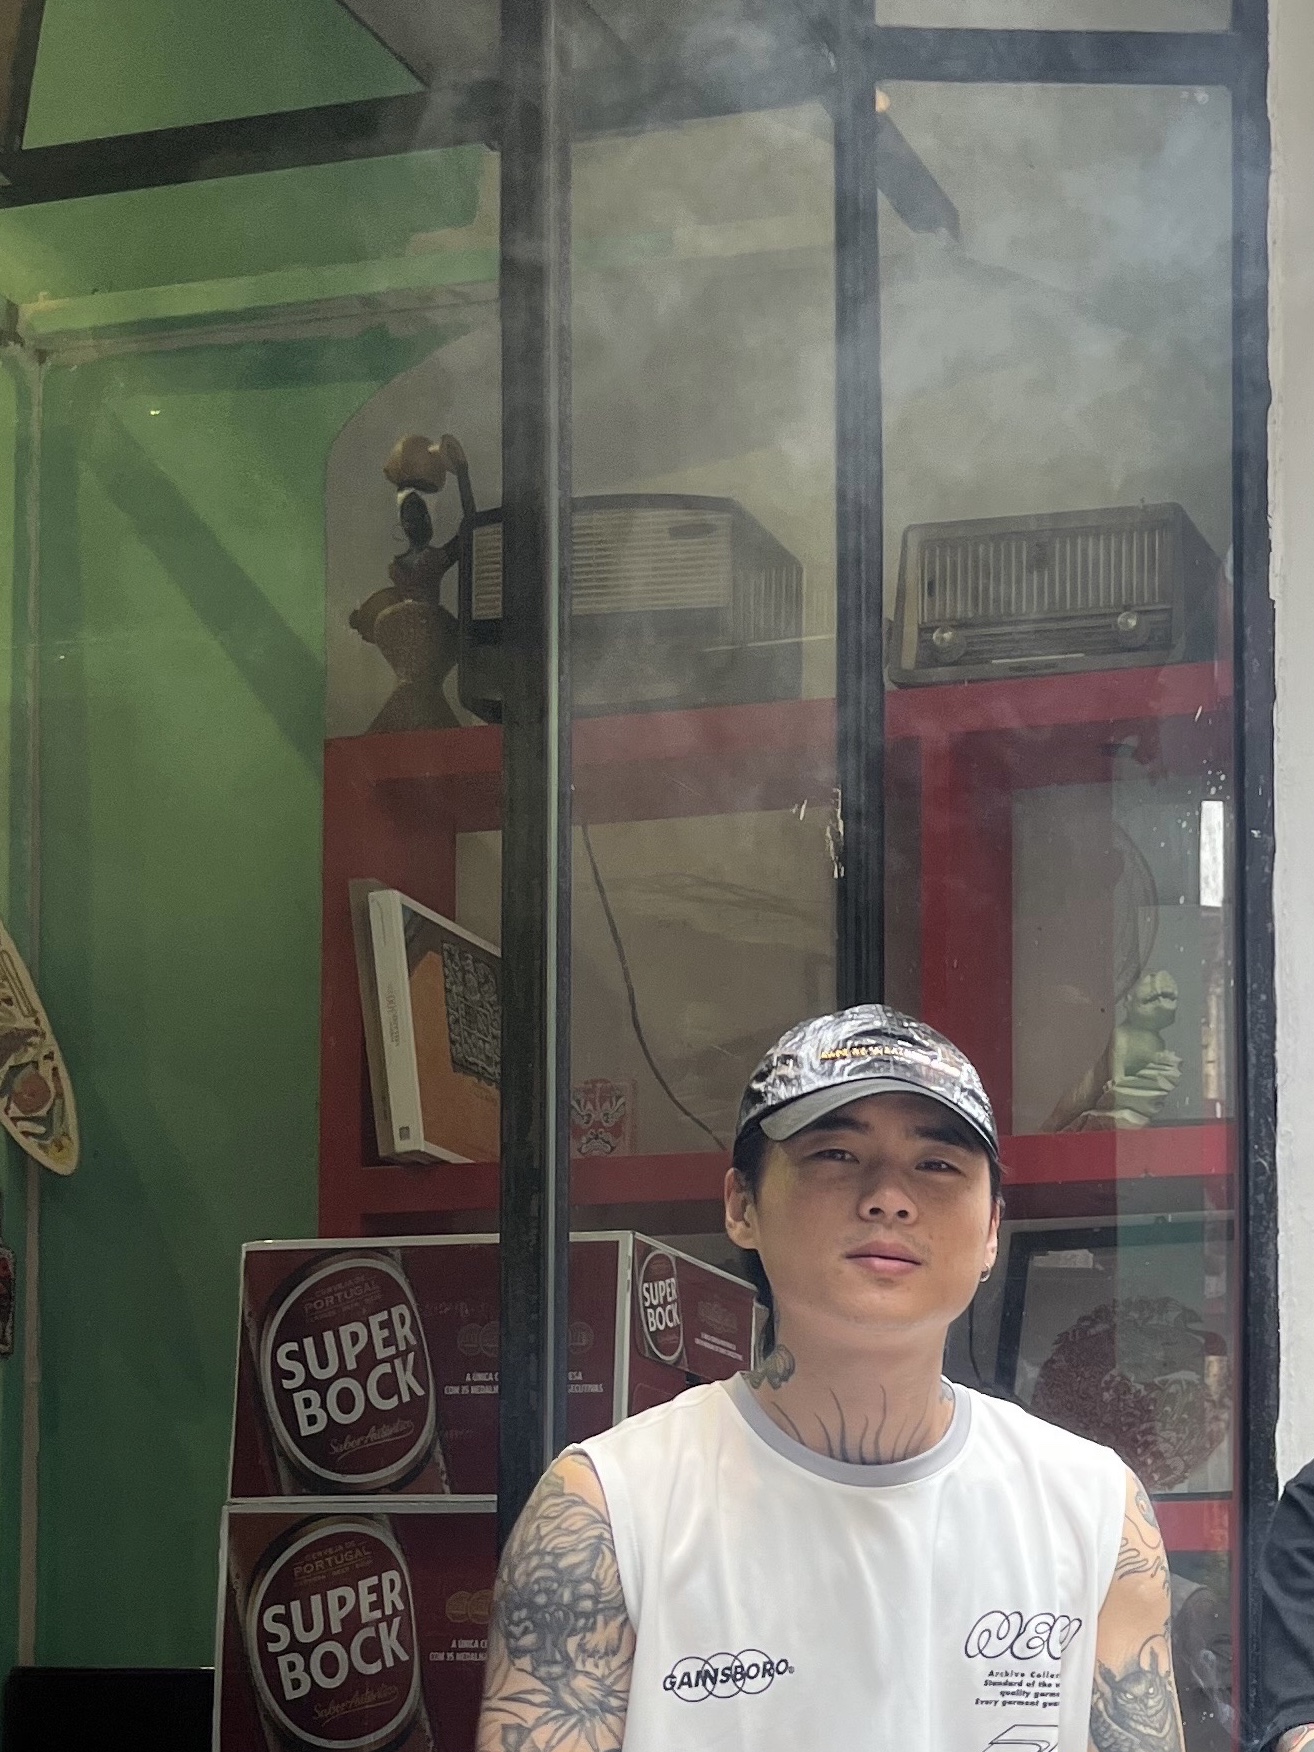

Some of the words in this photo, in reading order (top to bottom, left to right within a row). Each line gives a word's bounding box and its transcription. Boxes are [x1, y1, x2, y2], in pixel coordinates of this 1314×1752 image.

[642, 1277, 678, 1307] SUPER
[646, 1302, 681, 1332] BOCK
[276, 1303, 418, 1390] SUPER
[292, 1352, 426, 1437] BOCK
[293, 1546, 373, 1579] PORTUGAL
[262, 1569, 405, 1653] SUPER
[276, 1617, 409, 1701] BOCK
[662, 1658, 789, 1691] GAINSBORO
[988, 1669, 1025, 1678] Archive
